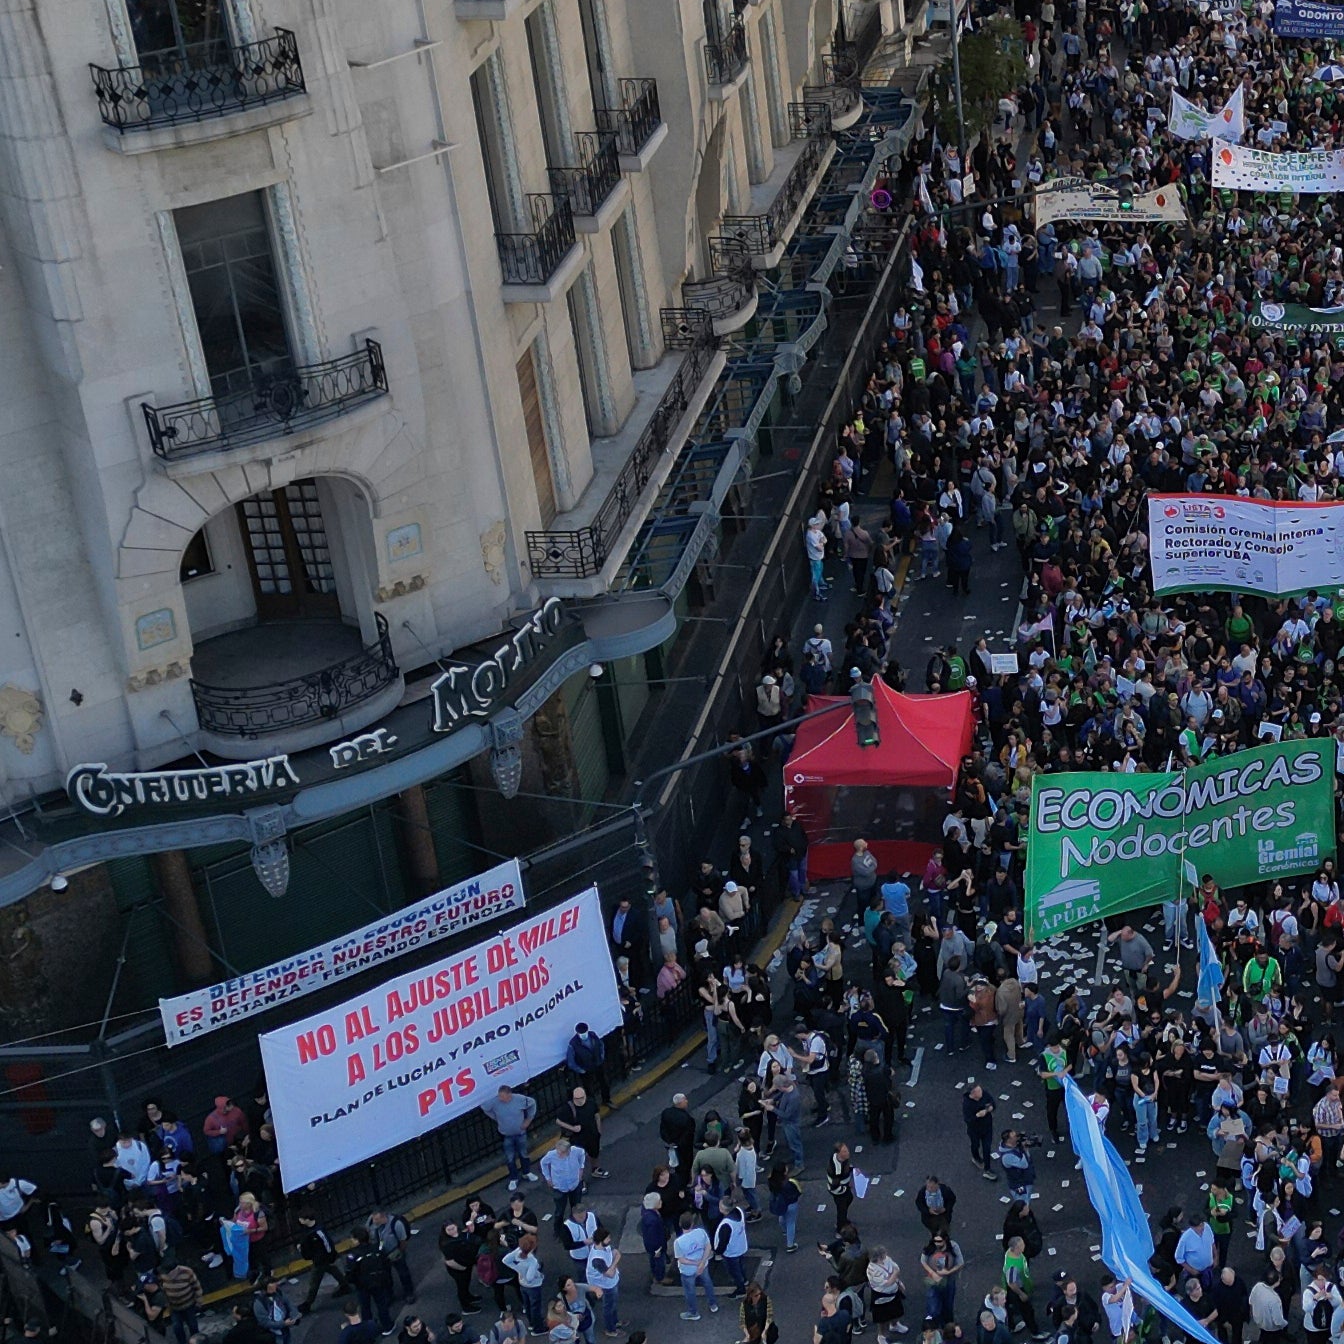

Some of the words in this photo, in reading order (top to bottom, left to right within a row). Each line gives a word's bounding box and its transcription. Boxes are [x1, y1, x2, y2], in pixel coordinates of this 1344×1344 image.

[1251, 151, 1335, 163] PRESENTES
[1165, 523, 1226, 536] Comisión
[1228, 526, 1277, 542] Gremial
[1278, 526, 1324, 542] Interna
[1213, 506, 1226, 519] 3
[1165, 535, 1232, 549] Rectorado
[1234, 539, 1242, 552] y
[1244, 540, 1294, 555] Consejo
[1165, 548, 1222, 562] Superior
[1224, 549, 1251, 562] UBA
[67, 755, 300, 816] CONFITERIA
[330, 728, 398, 769] DEL
[430, 596, 565, 733] MOLINO
[1037, 752, 1322, 833] ECONÓMICAS
[1060, 800, 1297, 878] Nodocentes
[1257, 838, 1275, 853] La
[1258, 843, 1319, 864] Gremial
[1258, 858, 1319, 875] Económicas
[1040, 902, 1100, 932] APUBA
[176, 1004, 203, 1028] ES
[211, 962, 326, 1013] DEFENDER
[333, 918, 427, 966] NUESTRO
[434, 882, 515, 925] FUTURO
[180, 1022, 202, 1038] LA
[210, 983, 300, 1025] MATANZA
[322, 936, 421, 982] FERNANDO
[427, 899, 516, 939] ESPINOZA
[296, 1024, 337, 1065] NO
[345, 1007, 380, 1047] AL
[385, 957, 480, 1022] AJUSTE
[487, 939, 519, 976] DE
[516, 906, 582, 958] MILEI
[347, 1052, 365, 1088] A
[372, 1029, 420, 1073] LOS
[426, 956, 551, 1044] JUBILADOS
[310, 1099, 361, 1129] PLAN
[362, 1083, 385, 1106] DE
[387, 1057, 447, 1092] LUCHA
[447, 1047, 460, 1062] Y
[462, 1023, 512, 1056] PARO
[513, 978, 584, 1033] NACIONAL
[417, 1067, 477, 1118] PTS
